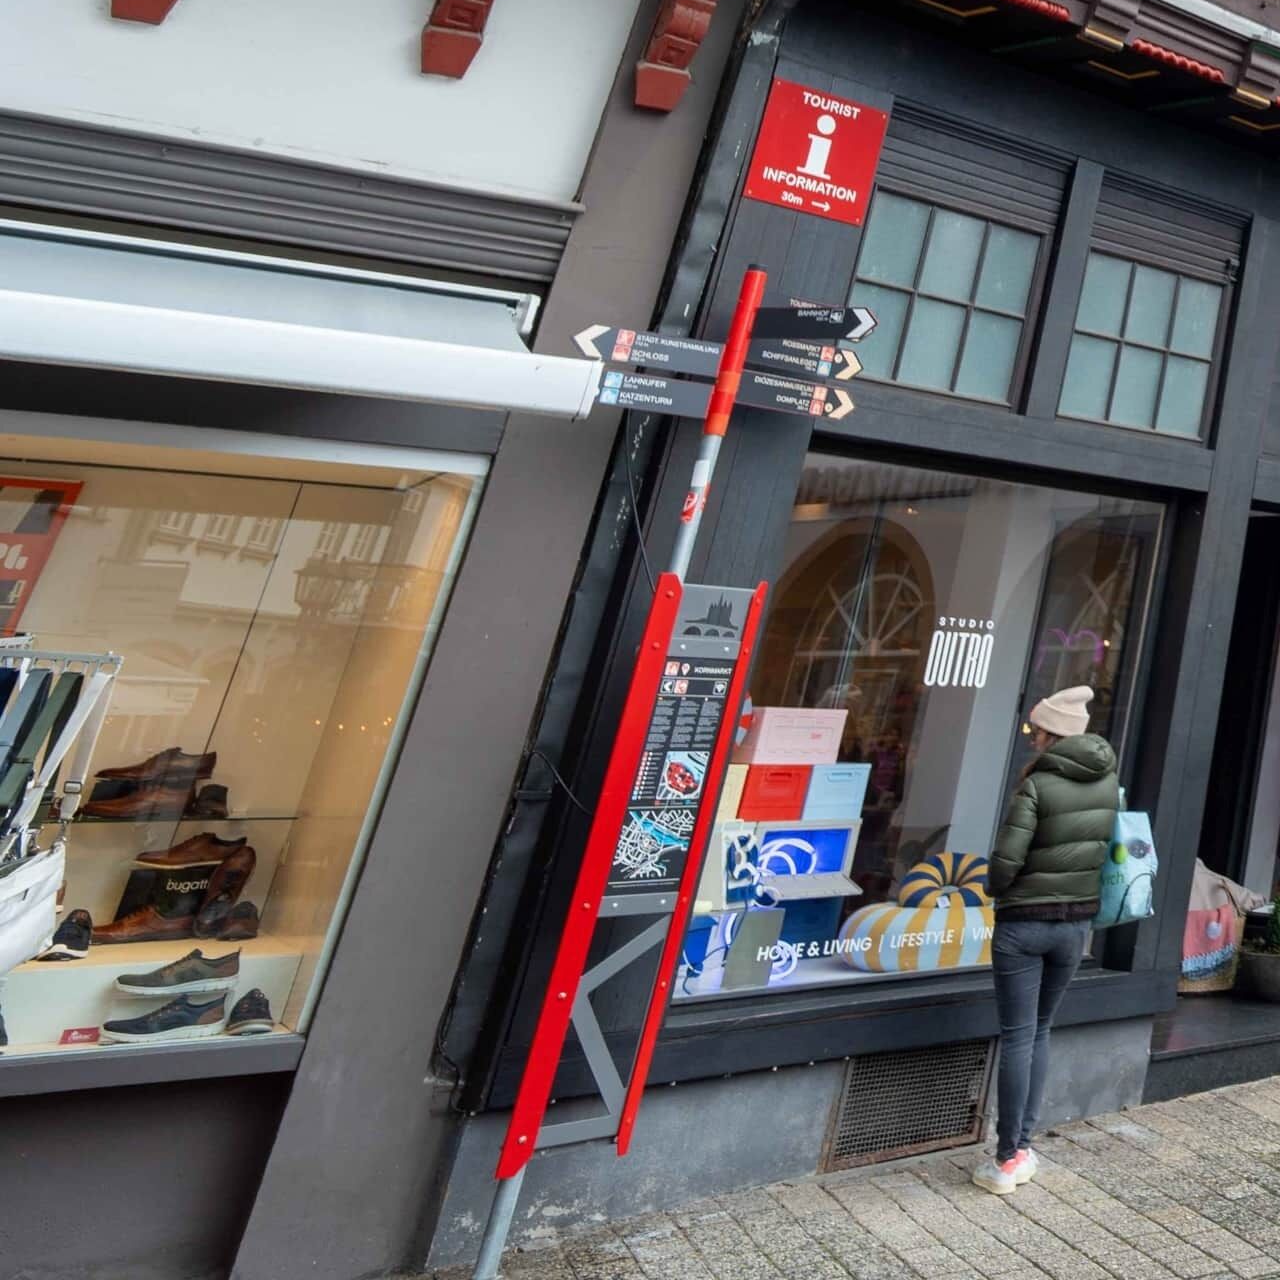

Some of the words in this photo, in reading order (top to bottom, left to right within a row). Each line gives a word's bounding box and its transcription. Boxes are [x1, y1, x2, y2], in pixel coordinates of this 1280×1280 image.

[803, 91, 861, 120] TOURIST
[762, 166, 857, 203] INFORMATION
[781, 190, 803, 206] 30m
[631, 349, 670, 362] SCHLOSS
[623, 375, 667, 389] LAHNUFER
[620, 391, 673, 406] KATZENTURM
[776, 394, 810, 407] DOMPLATZ
[939, 616, 994, 630] STUDIO
[924, 630, 995, 689] OUTRO
[694, 666, 734, 675] KORNMARKT
[807, 940, 820, 958] &
[823, 936, 873, 956] LIVING
[889, 928, 955, 949] LIFESTYLE
